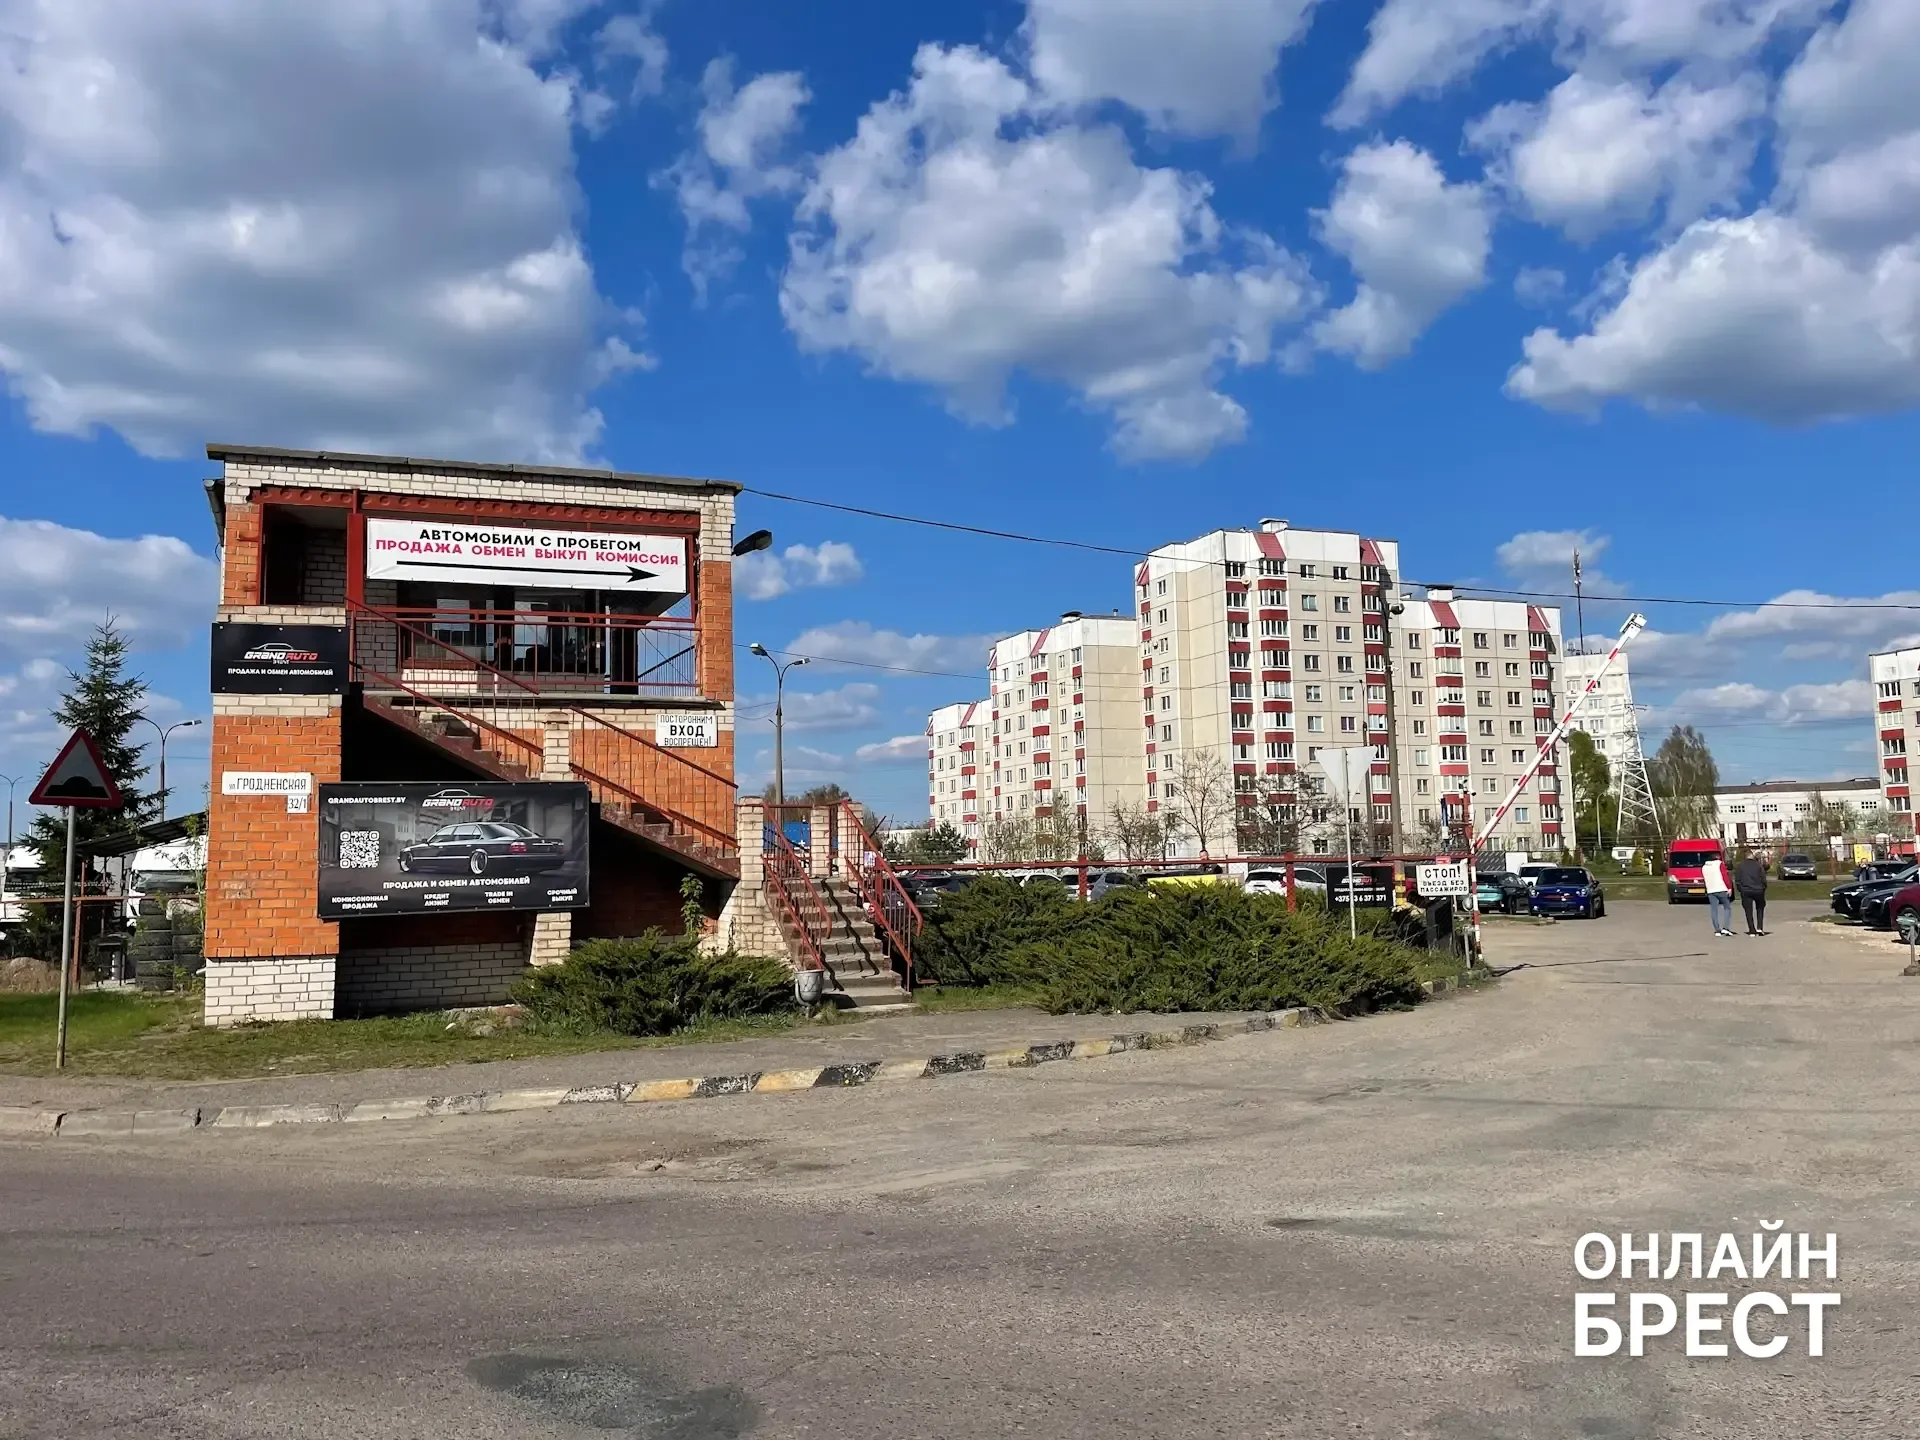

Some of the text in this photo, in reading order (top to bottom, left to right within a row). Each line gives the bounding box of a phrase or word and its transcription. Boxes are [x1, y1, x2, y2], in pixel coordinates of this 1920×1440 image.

[419, 528, 641, 551] АВТОМОБИЛИ С ПРОБЕГОМ
[375, 539, 679, 565] ПРОДАЖА ОБМЕН ВЫКУП КОМИССИЯ
[289, 668, 333, 676] АВТОМОБИЛЕЙ
[660, 714, 713, 724] ПОСТОРОННИМ
[670, 725, 704, 737] ВХОД
[664, 736, 712, 746] ВОСПРЕЩЕН!
[236, 778, 307, 791] ГРОДНЕНСКАЯ
[288, 797, 307, 810] 32/1
[327, 796, 406, 804] GRANDAUTOBREST.BY
[1424, 865, 1461, 878] СТОП!
[383, 875, 530, 890] ПРОДАЖА И ОБМЕН АВТОМОБИЛЕЙ
[547, 887, 578, 896] СРОЧНЫЙ
[332, 895, 389, 903] КОМИССИОННАЯ
[1376, 894, 1387, 902] 371
[342, 902, 378, 910] ПРОДАЖА
